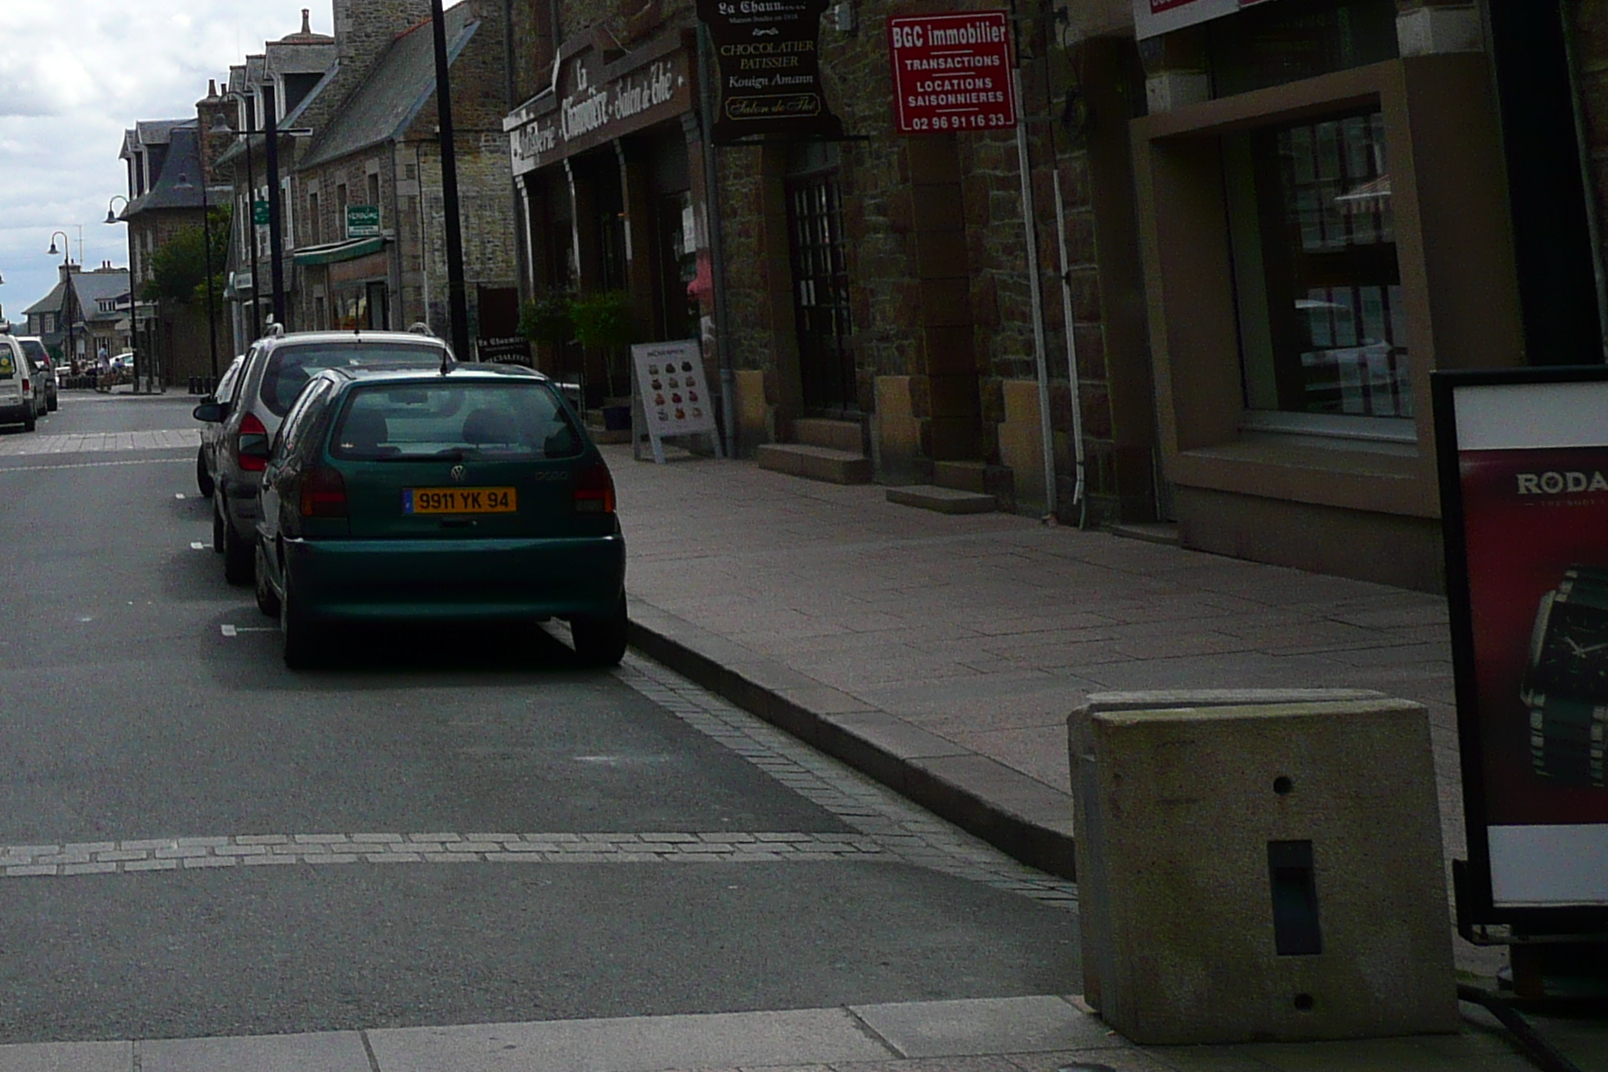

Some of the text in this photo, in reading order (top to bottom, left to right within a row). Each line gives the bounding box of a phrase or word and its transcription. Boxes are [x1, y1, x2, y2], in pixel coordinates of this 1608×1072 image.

[892, 20, 1005, 48] BGC immobilier
[720, 40, 815, 57] CHOCOLATIER
[740, 56, 799, 71] PATISSIER
[905, 55, 1000, 71] TRANSACTIONS
[728, 72, 814, 90] Kouign Amann
[917, 77, 992, 93] LOCATIONS
[730, 99, 769, 115] Salon
[771, 99, 784, 114] de
[908, 91, 1004, 107] SAISONNIERES
[912, 113, 1004, 130] 02 96 91 16 33
[1515, 470, 1608, 495] RODA
[419, 490, 509, 510] 9911 YK 94
